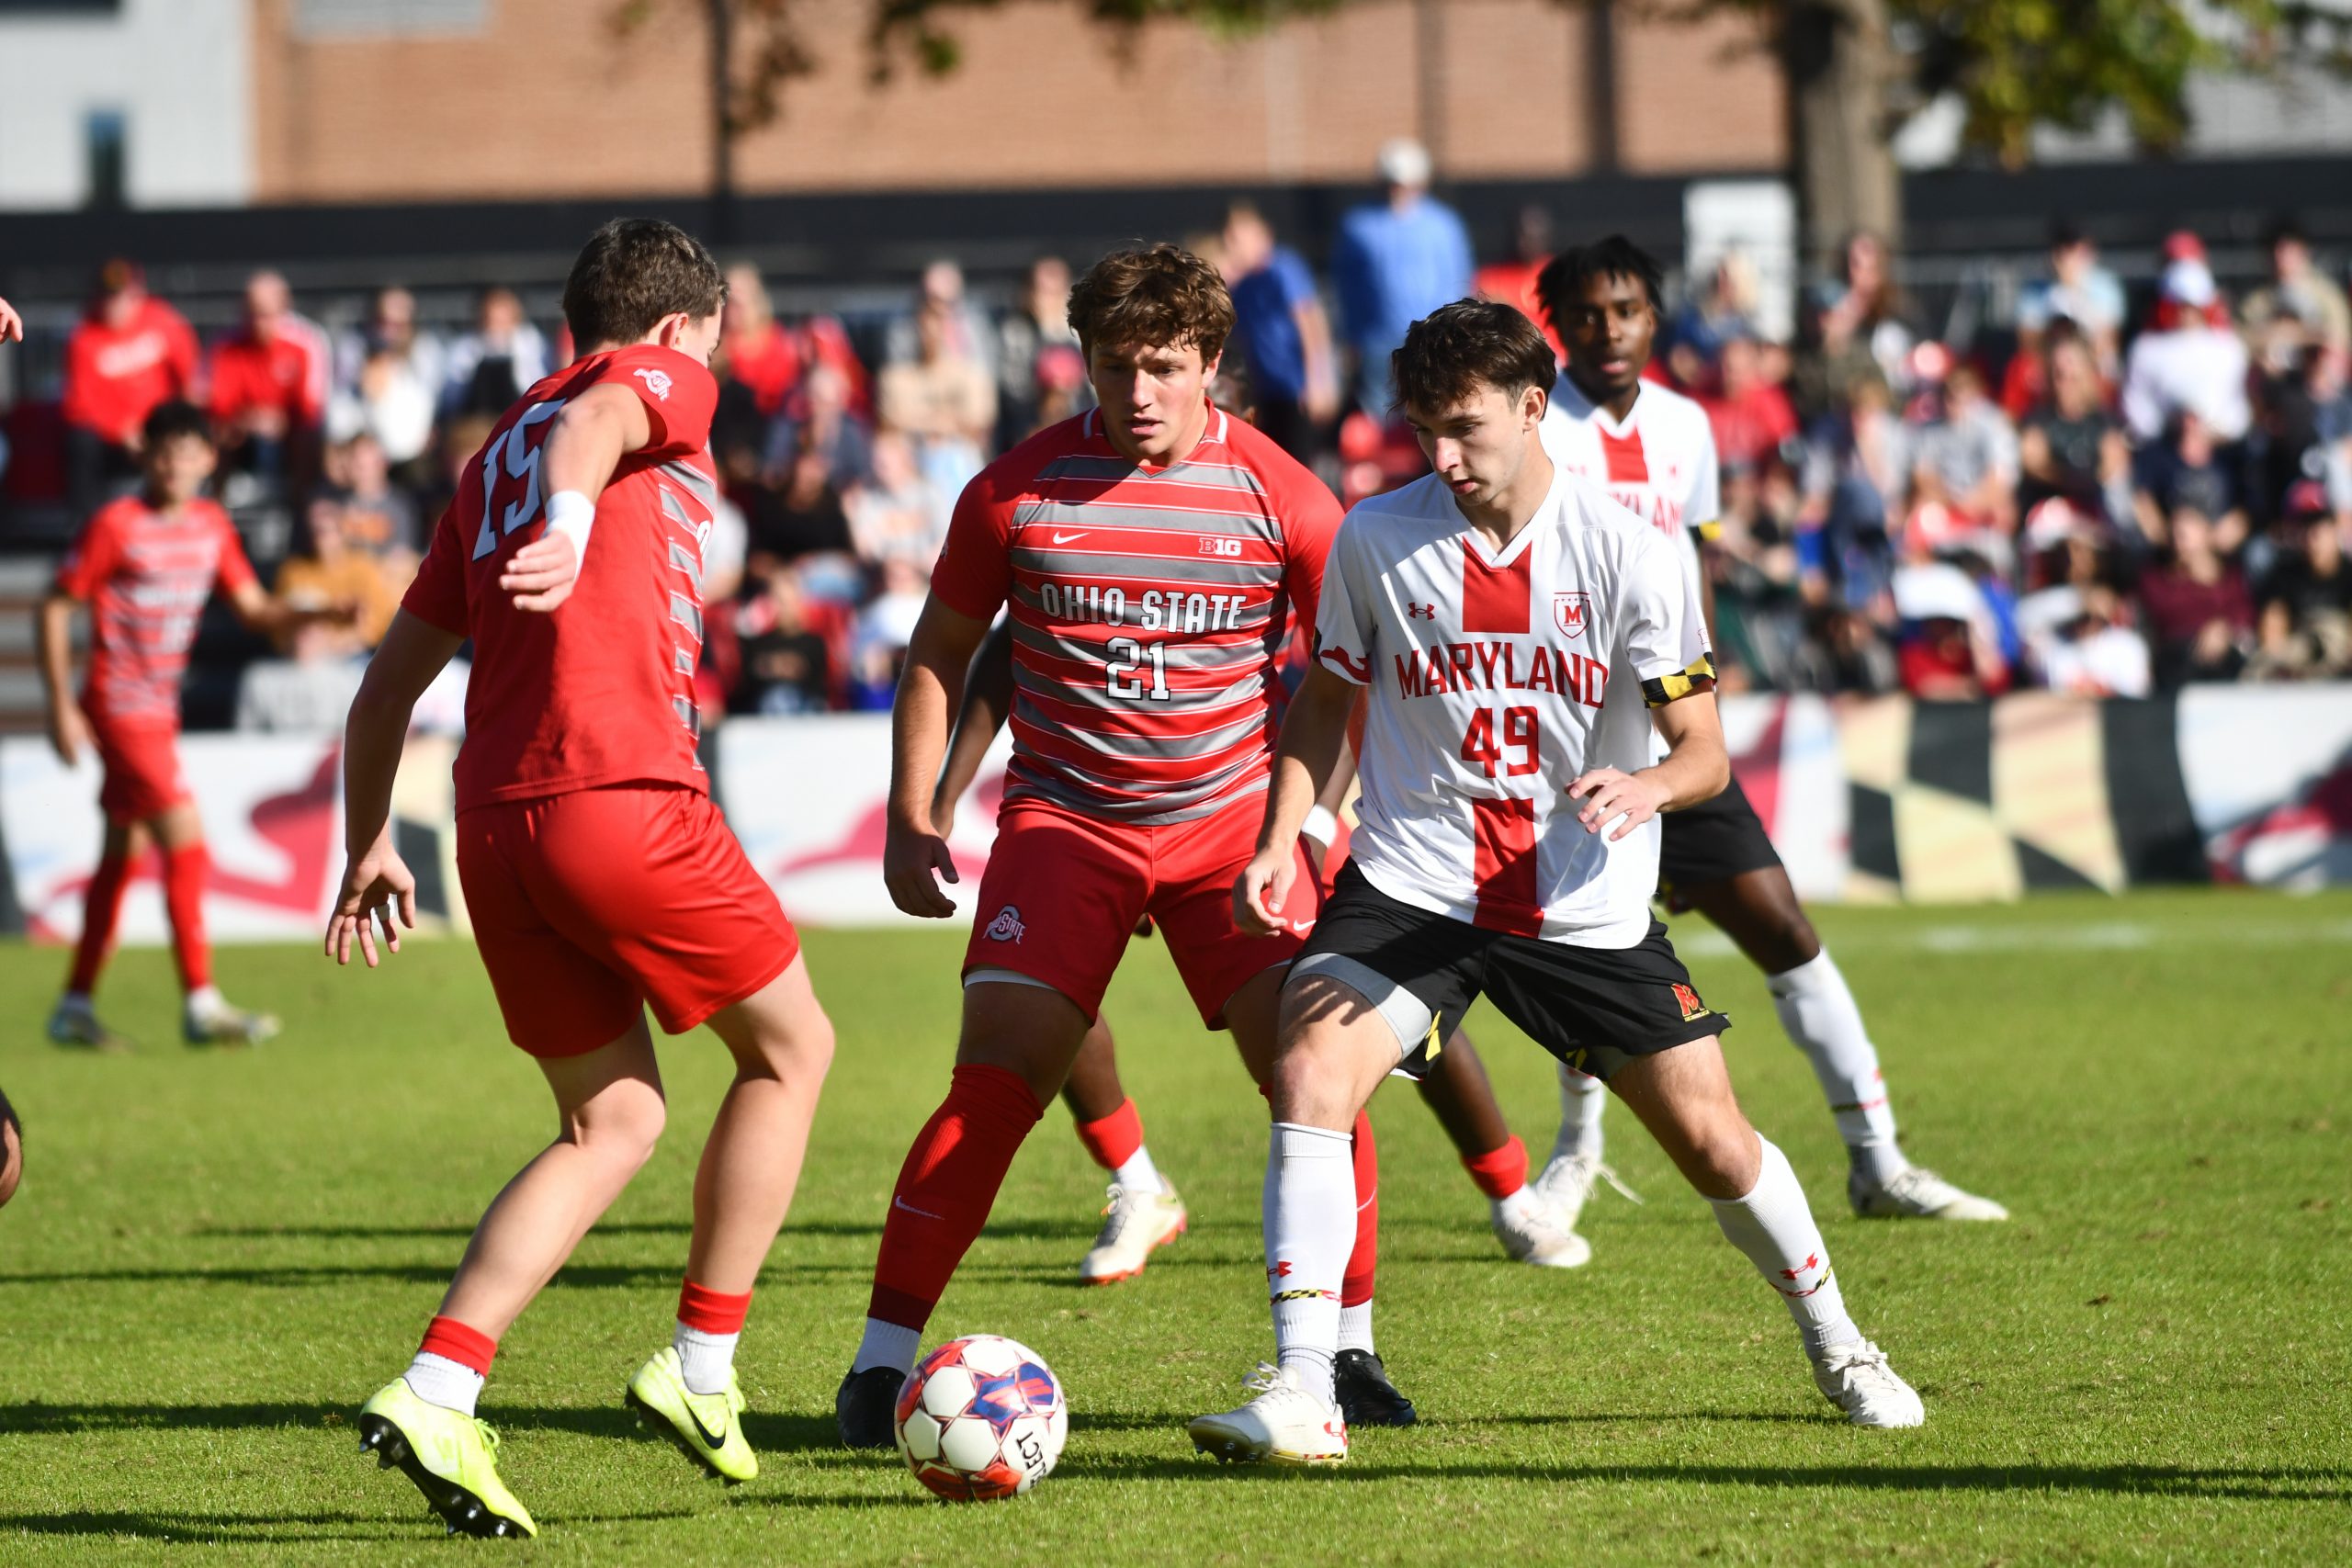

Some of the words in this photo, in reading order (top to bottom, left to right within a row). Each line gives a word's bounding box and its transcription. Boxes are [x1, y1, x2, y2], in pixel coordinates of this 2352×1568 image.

[472, 397, 567, 561] 15
[1040, 582, 1125, 627] OHIO
[1140, 589, 1248, 634] STATE
[1564, 604, 1582, 624] M
[1106, 636, 1170, 701] 21
[1394, 641, 1609, 709] MARYLAND
[1461, 705, 1540, 779] 49
